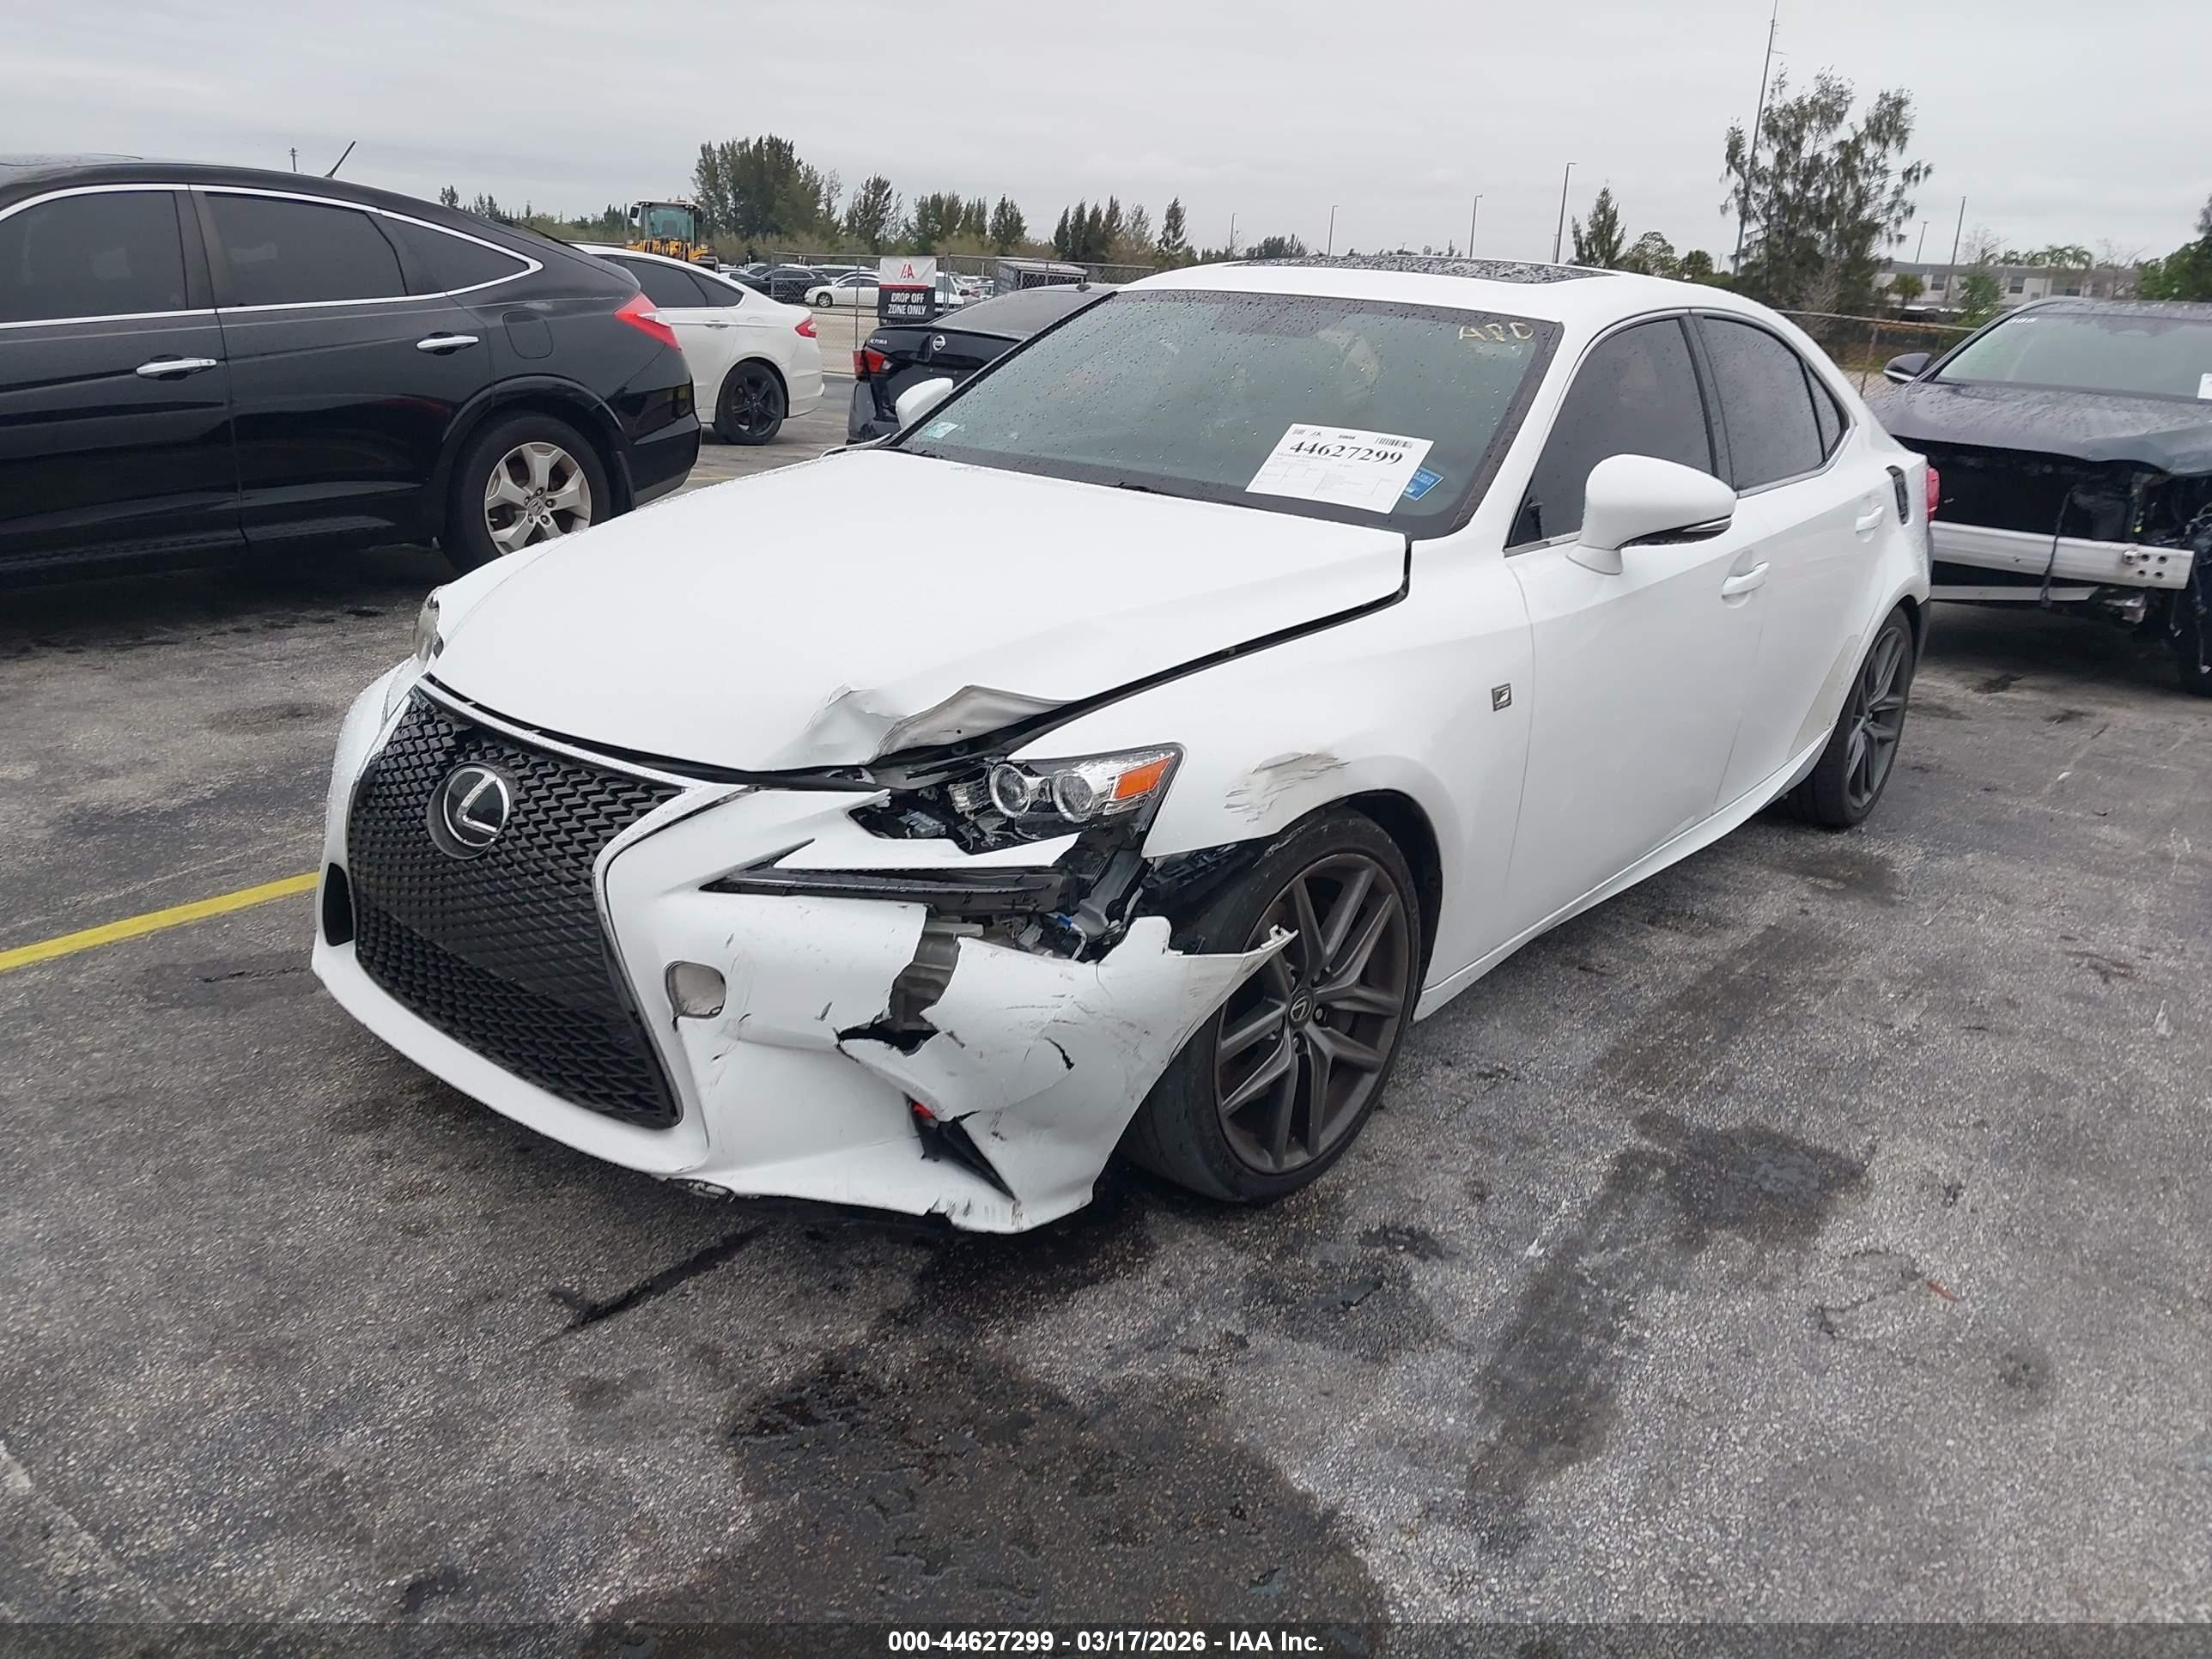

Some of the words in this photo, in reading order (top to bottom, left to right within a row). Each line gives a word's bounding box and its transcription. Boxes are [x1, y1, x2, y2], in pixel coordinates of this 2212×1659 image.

[890, 292, 910, 303] DROP
[911, 293, 925, 303] OFF
[887, 304, 907, 315] ZONE
[907, 305, 927, 315] ONLY
[1290, 441, 1403, 465] 44627299
